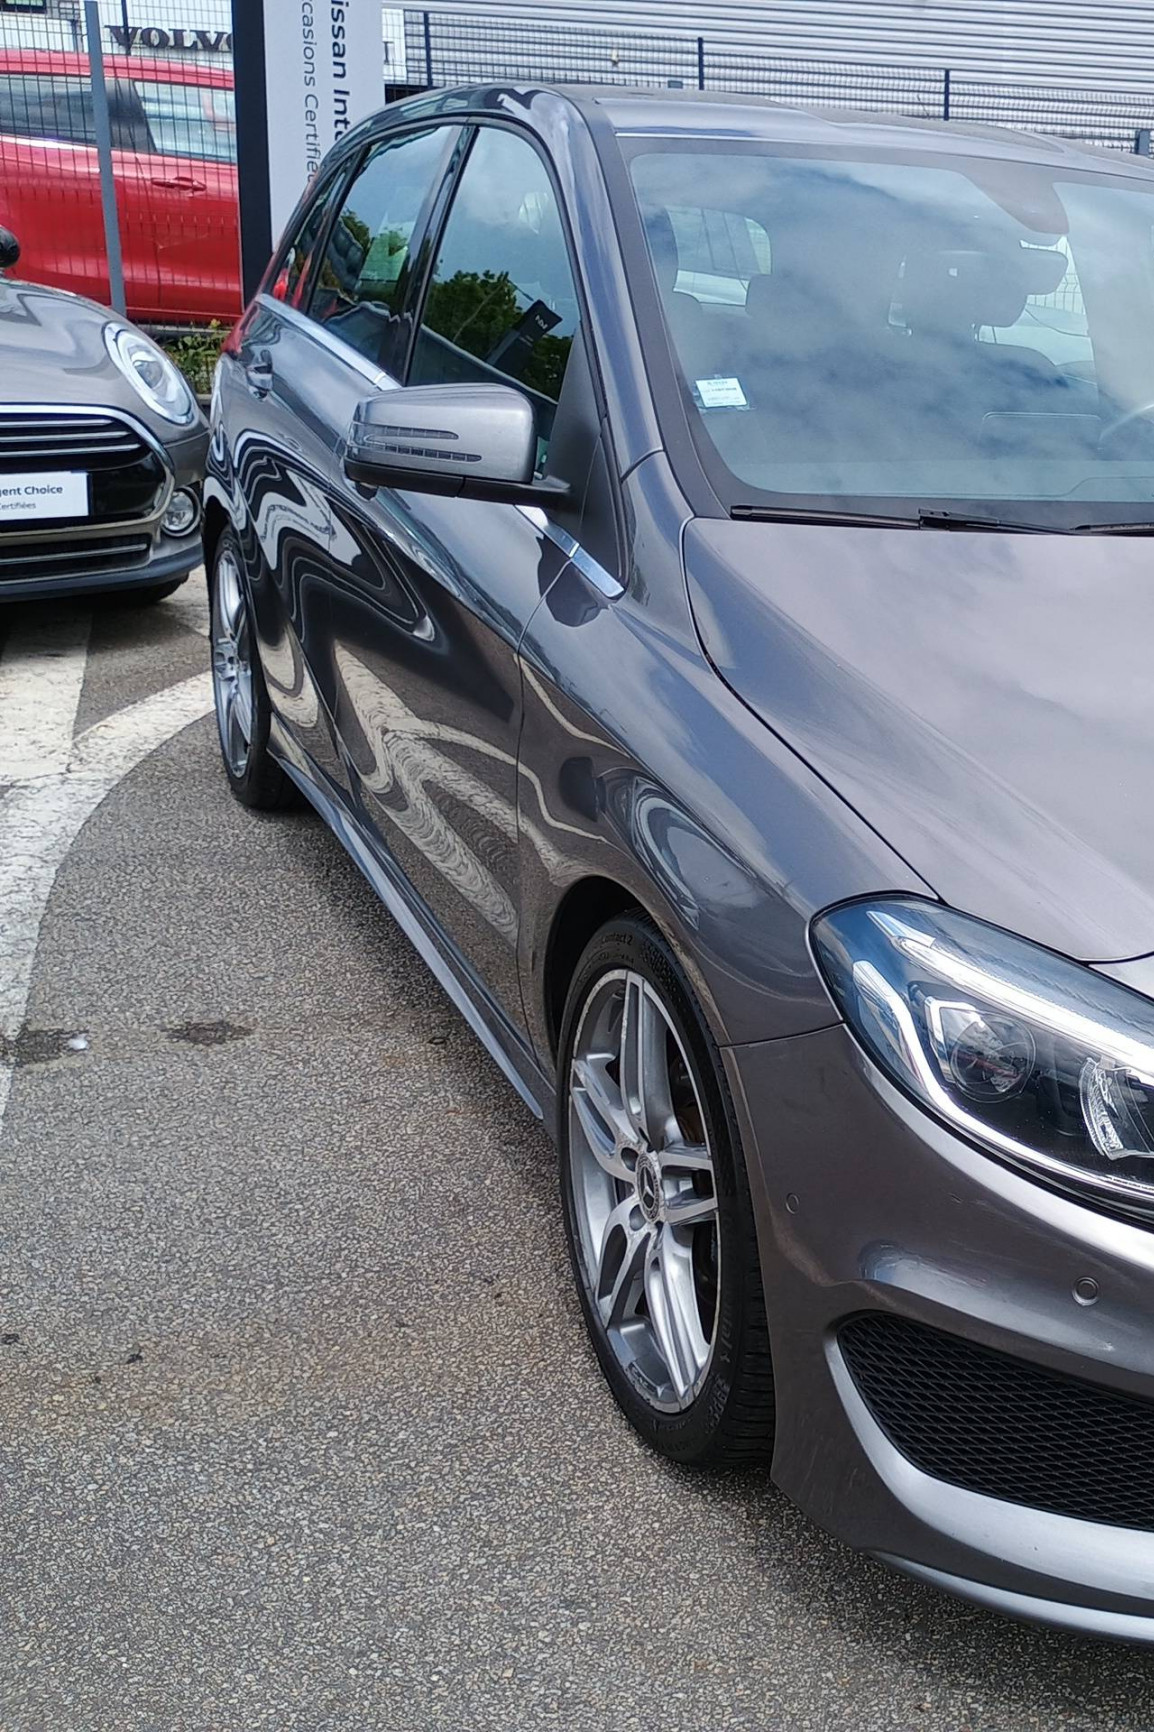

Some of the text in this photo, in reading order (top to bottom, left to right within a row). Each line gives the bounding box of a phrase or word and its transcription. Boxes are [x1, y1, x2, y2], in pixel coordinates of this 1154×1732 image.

[103, 25, 232, 52] VOLV
[301, 0, 317, 87] casions
[331, 0, 349, 79] issan
[24, 484, 63, 495] Choice
[0, 502, 37, 510] ertifiées
